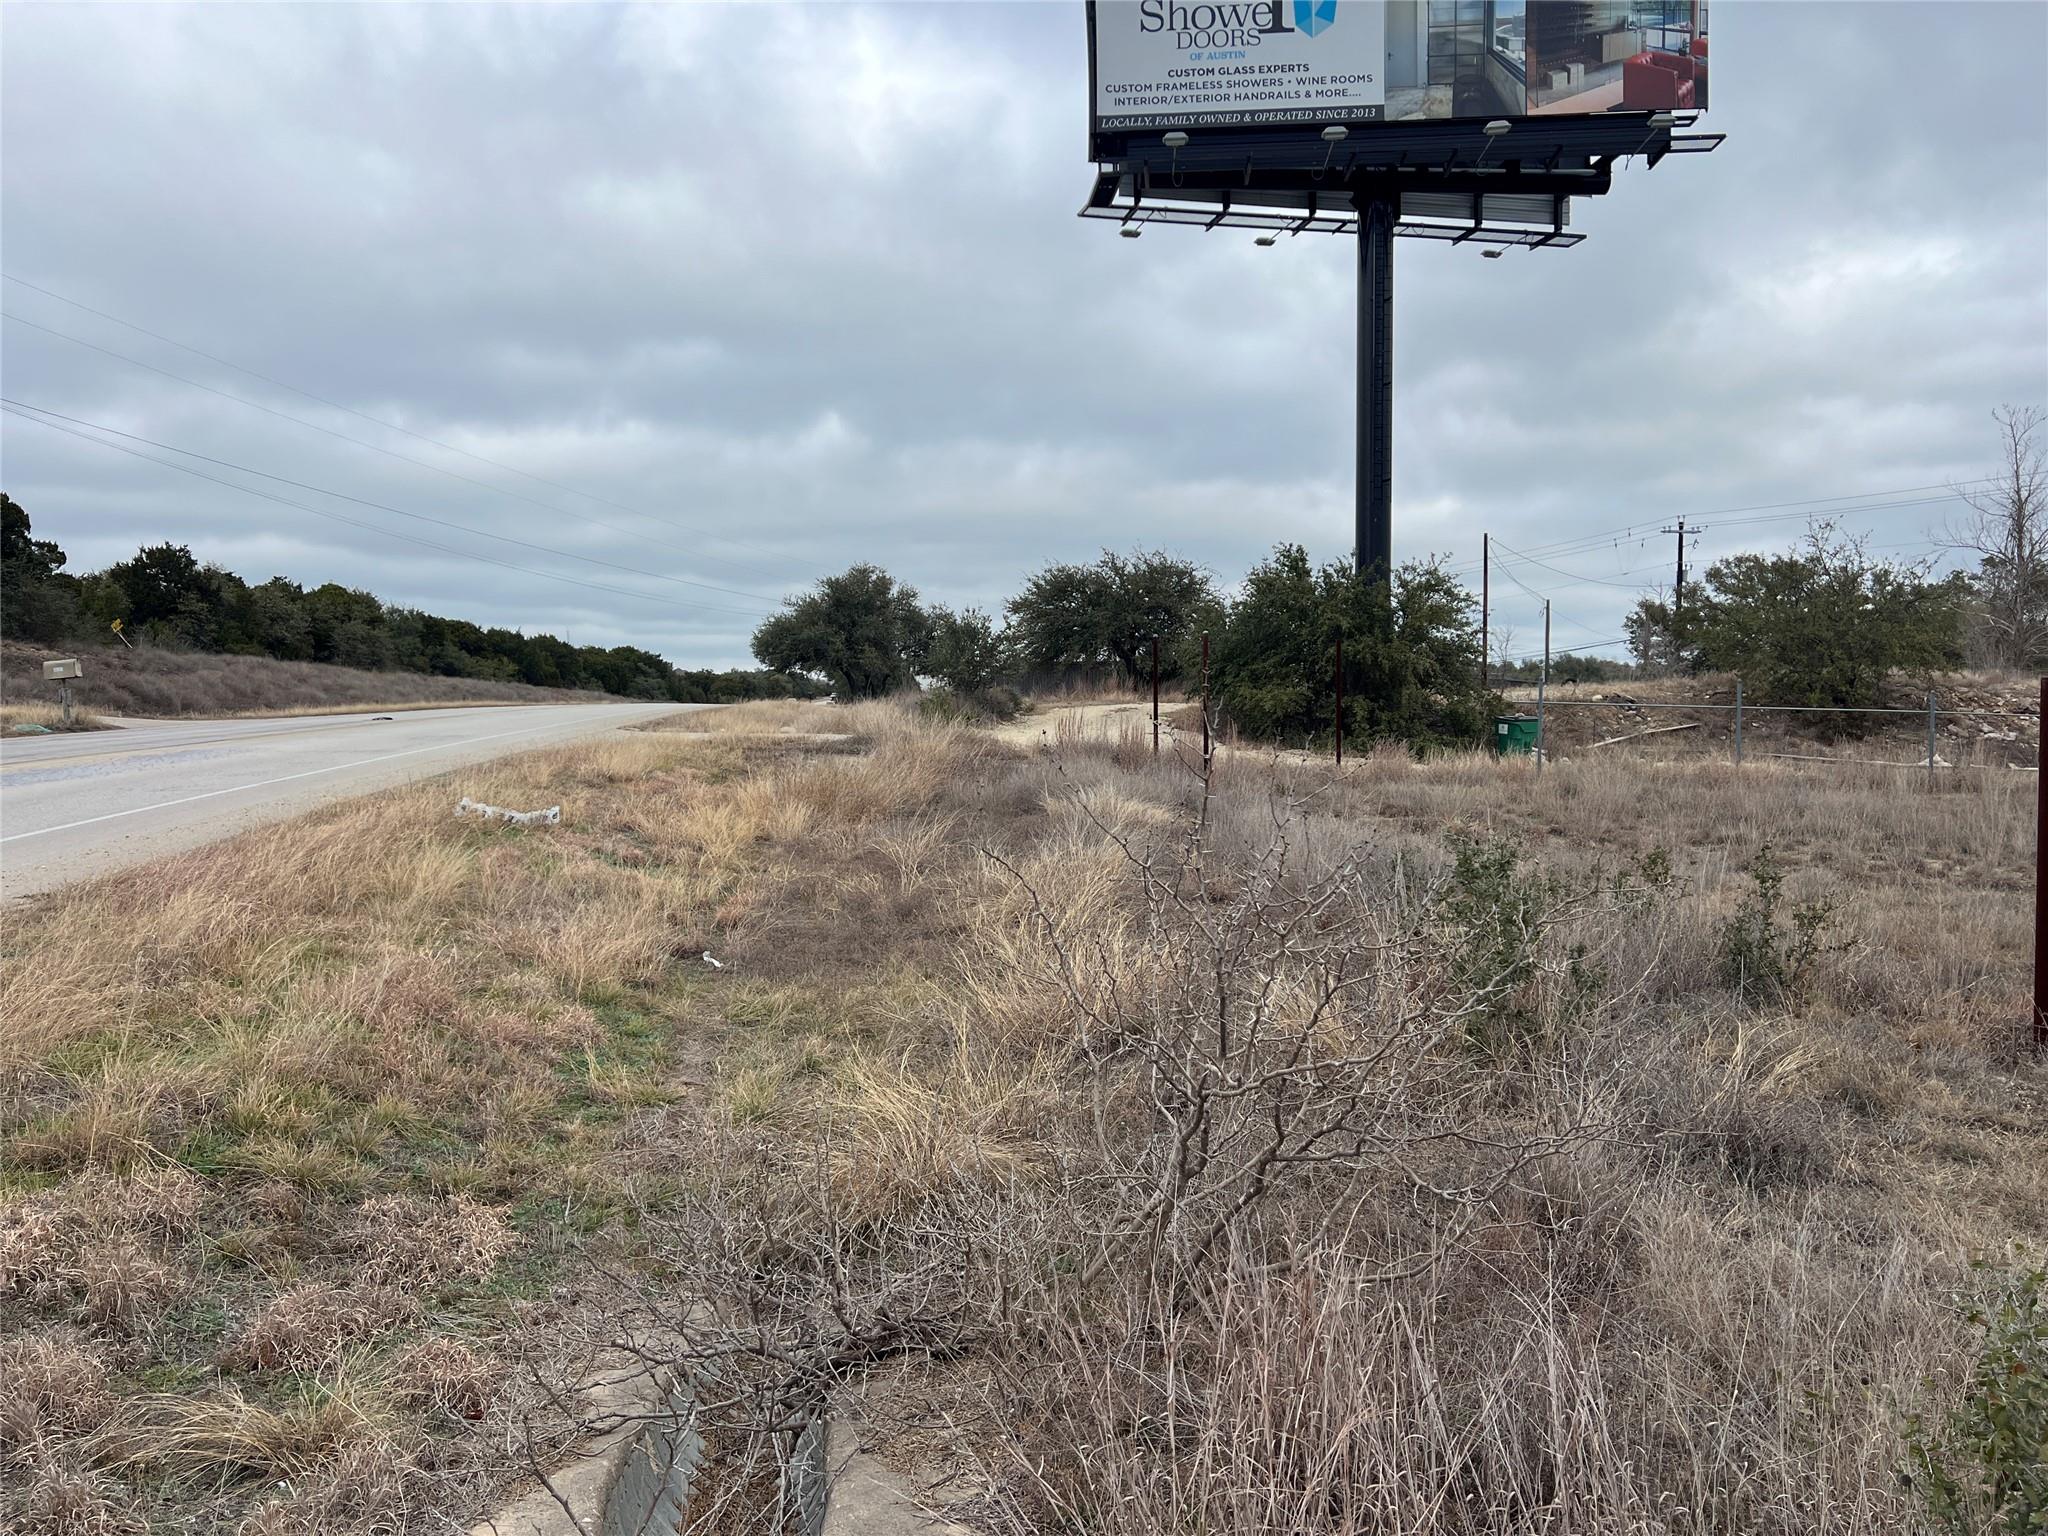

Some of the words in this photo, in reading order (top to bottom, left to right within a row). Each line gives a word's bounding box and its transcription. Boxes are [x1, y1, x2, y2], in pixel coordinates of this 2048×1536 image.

[1176, 28, 1261, 49] DOORS
[1190, 52, 1203, 61] OF
[1206, 50, 1246, 60] AUSTIN
[1167, 68, 1215, 78] CUSTOM
[1218, 66, 1255, 76] GLASS
[1258, 63, 1310, 74] EXPERTS
[1105, 84, 1153, 94] CUSTOM
[1156, 80, 1223, 92] FRAMELESS
[1226, 78, 1284, 90] SHOWERS
[1295, 76, 1327, 86] WINE
[1330, 74, 1374, 84] ROOMS
[1114, 94, 1231, 106] INTERIOR/EXTERIOR
[1234, 90, 1301, 102] HANDRAILS
[1304, 90, 1312, 99] &
[1102, 116, 1153, 128] LOCALLY,
[1155, 114, 1197, 126] FAMILY
[1199, 113, 1241, 124] OWNED
[1243, 112, 1252, 122] &
[1254, 110, 1313, 122] OPERATED
[1316, 108, 1349, 119] SINCE
[1351, 107, 1376, 118] 2013
